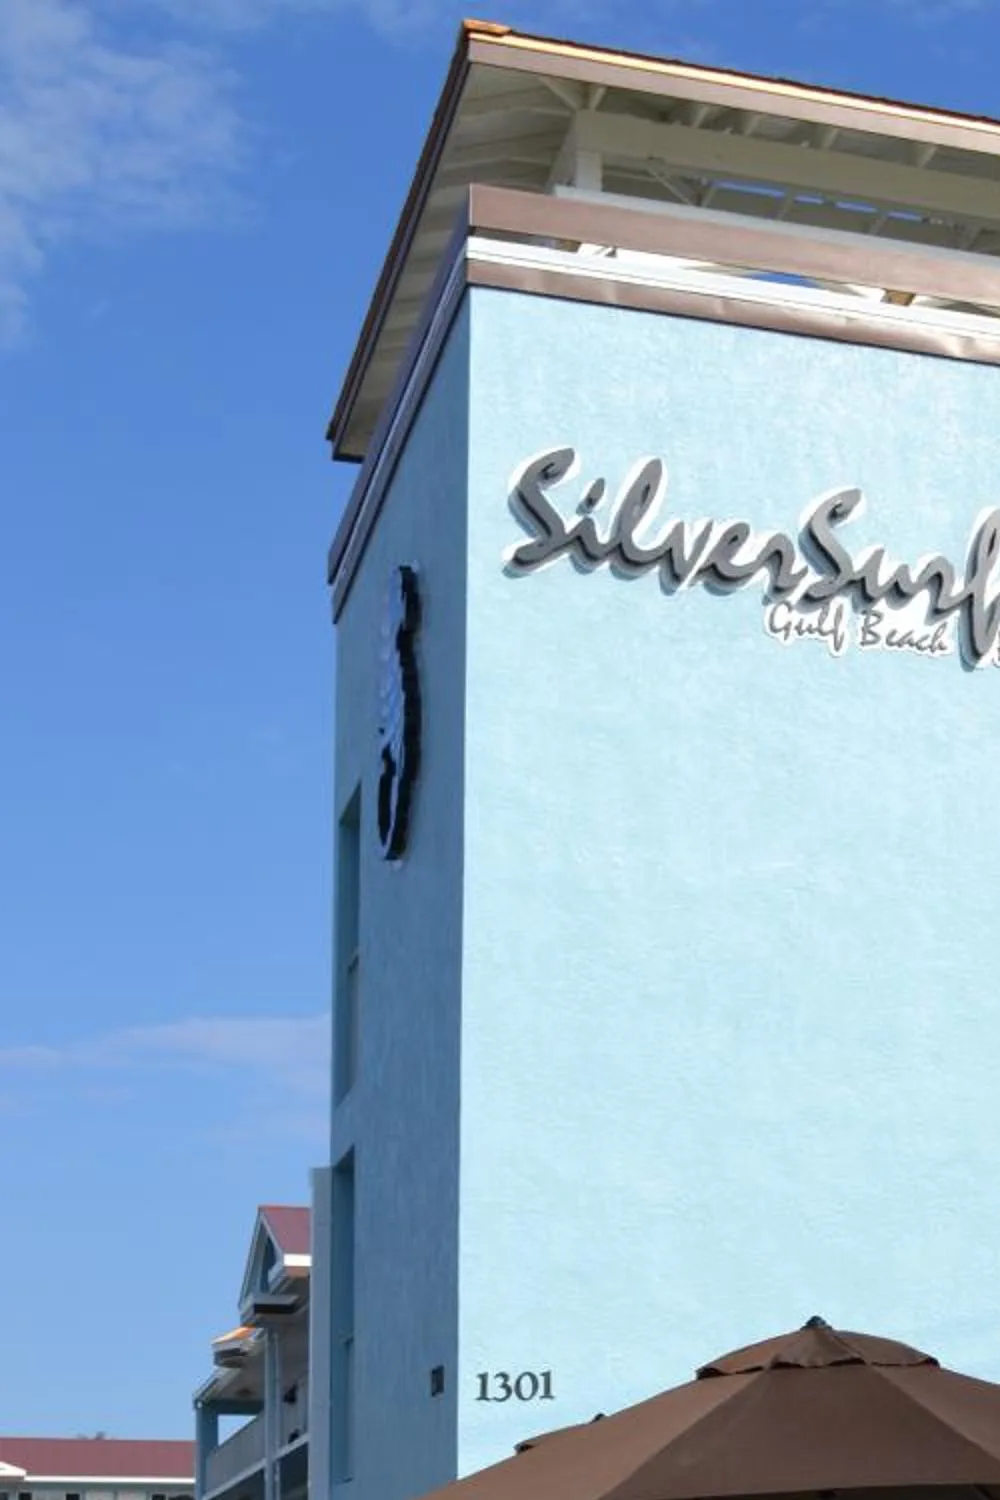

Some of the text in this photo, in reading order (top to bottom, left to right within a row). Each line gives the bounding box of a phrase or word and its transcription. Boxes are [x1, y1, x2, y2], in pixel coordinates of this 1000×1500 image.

[769, 601, 844, 651] Gulf
[860, 608, 950, 654] Beach
[475, 1369, 555, 1402] 1301
